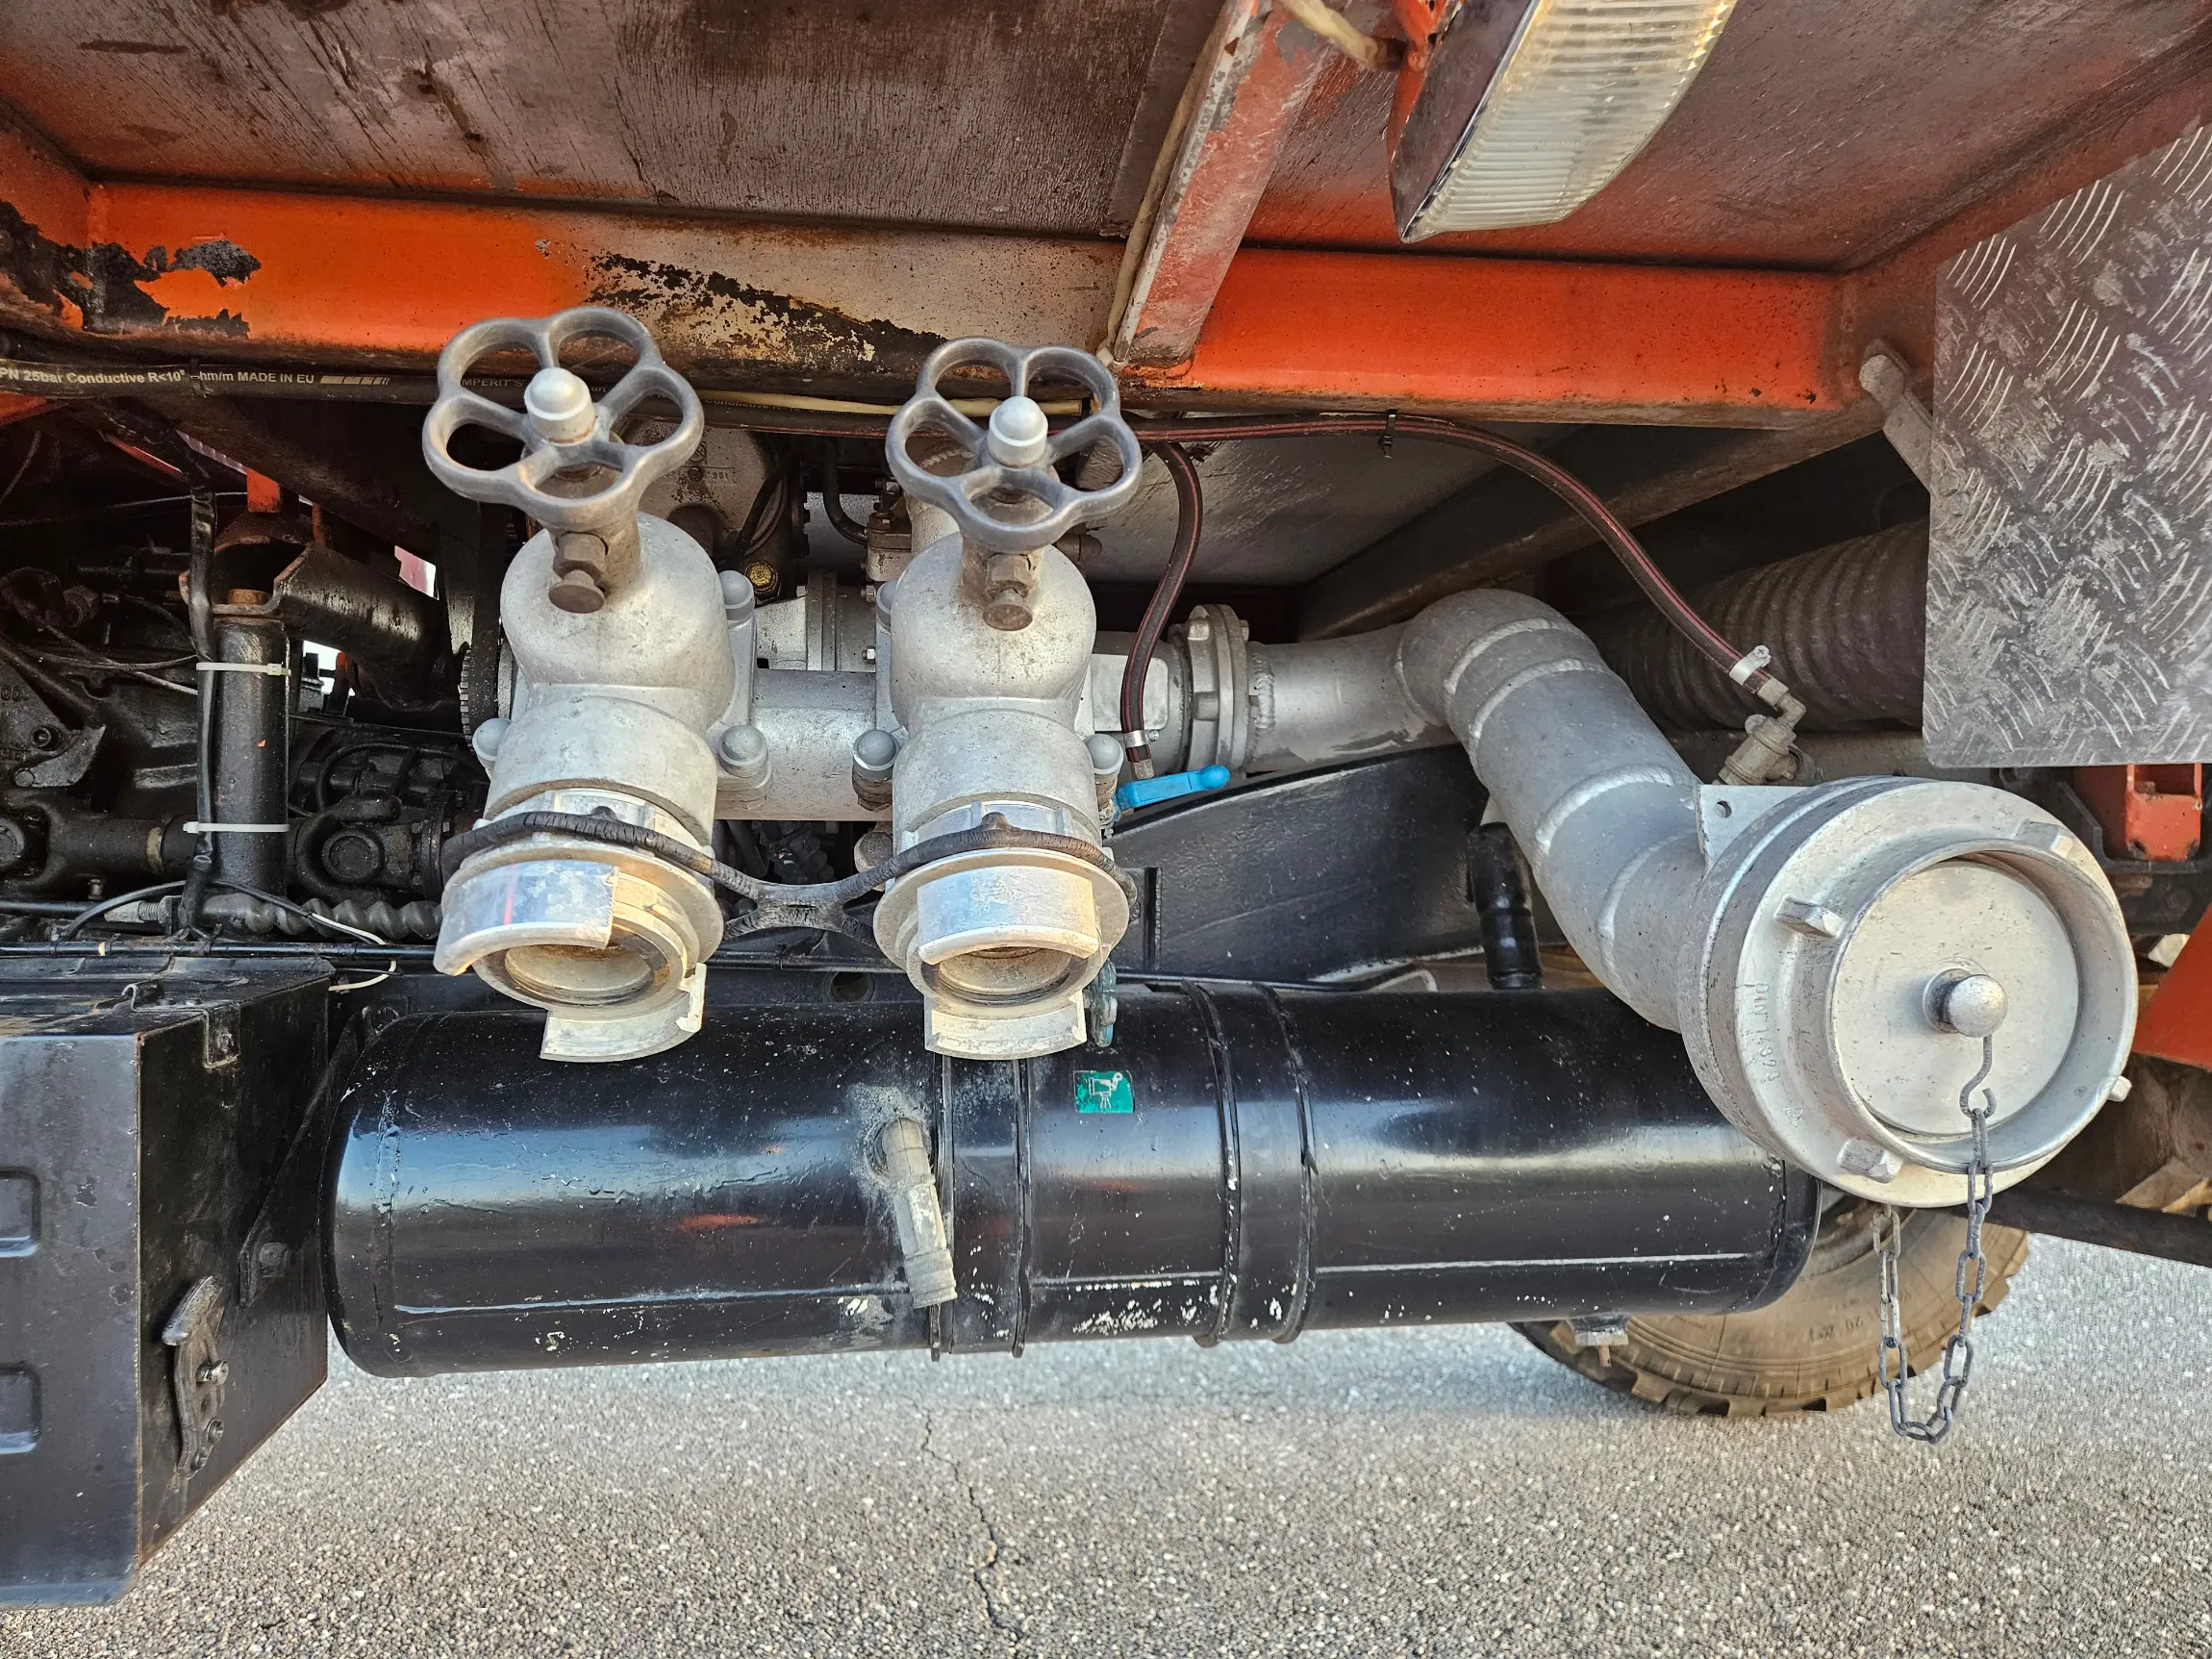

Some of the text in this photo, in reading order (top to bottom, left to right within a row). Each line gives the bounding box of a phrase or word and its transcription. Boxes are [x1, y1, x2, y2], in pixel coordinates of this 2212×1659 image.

[0, 367, 19, 381] PN
[23, 369, 63, 383] 25bar
[66, 371, 145, 384] Conductive
[191, 371, 234, 382] hm/m
[238, 371, 276, 383] MADE
[280, 372, 292, 383] IN
[296, 374, 314, 384] EU
[461, 378, 510, 387] MPERIT
